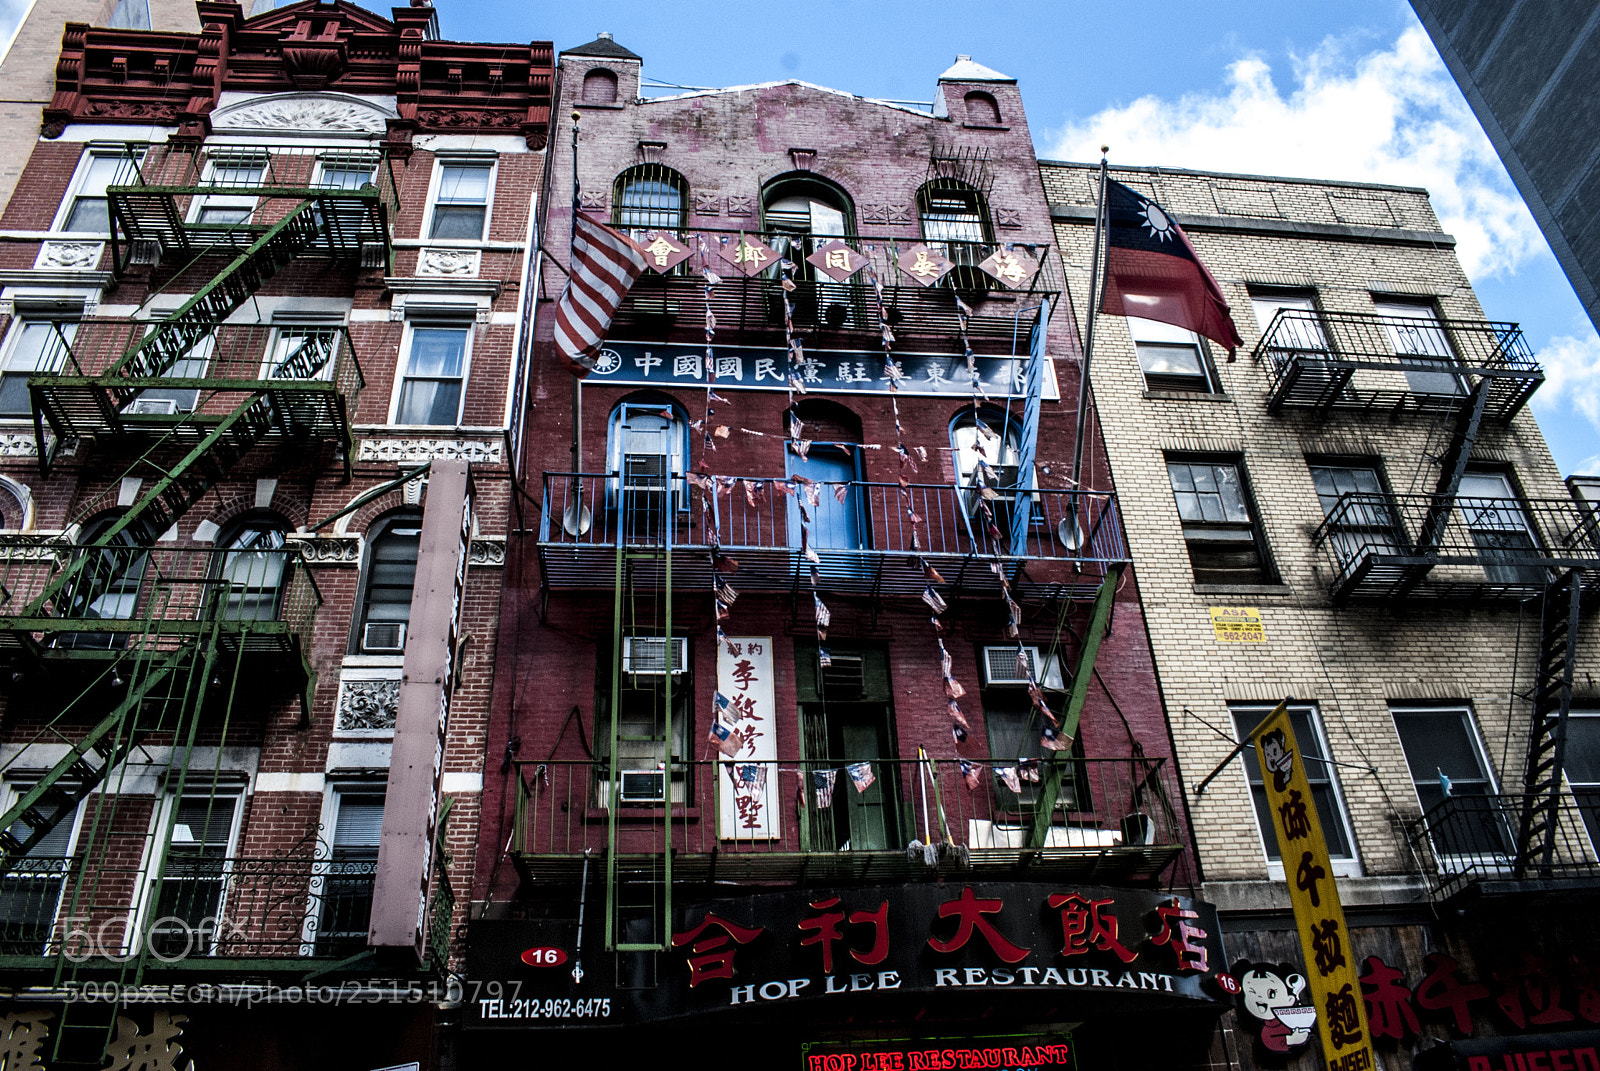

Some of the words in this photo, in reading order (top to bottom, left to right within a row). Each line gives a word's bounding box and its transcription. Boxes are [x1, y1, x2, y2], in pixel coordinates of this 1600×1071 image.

[1223, 632, 1262, 640] 562-2047
[533, 949, 558, 963] 16
[730, 979, 810, 1005] HOP
[824, 969, 902, 995] LEE
[935, 966, 1174, 992] RESTAURANT
[1221, 975, 1236, 991] 16
[479, 999, 611, 1018] TEL:212-962-6475
[808, 1054, 857, 1071] HOP
[861, 1052, 904, 1071] LEE
[907, 1044, 1069, 1070] RESTAURANT
